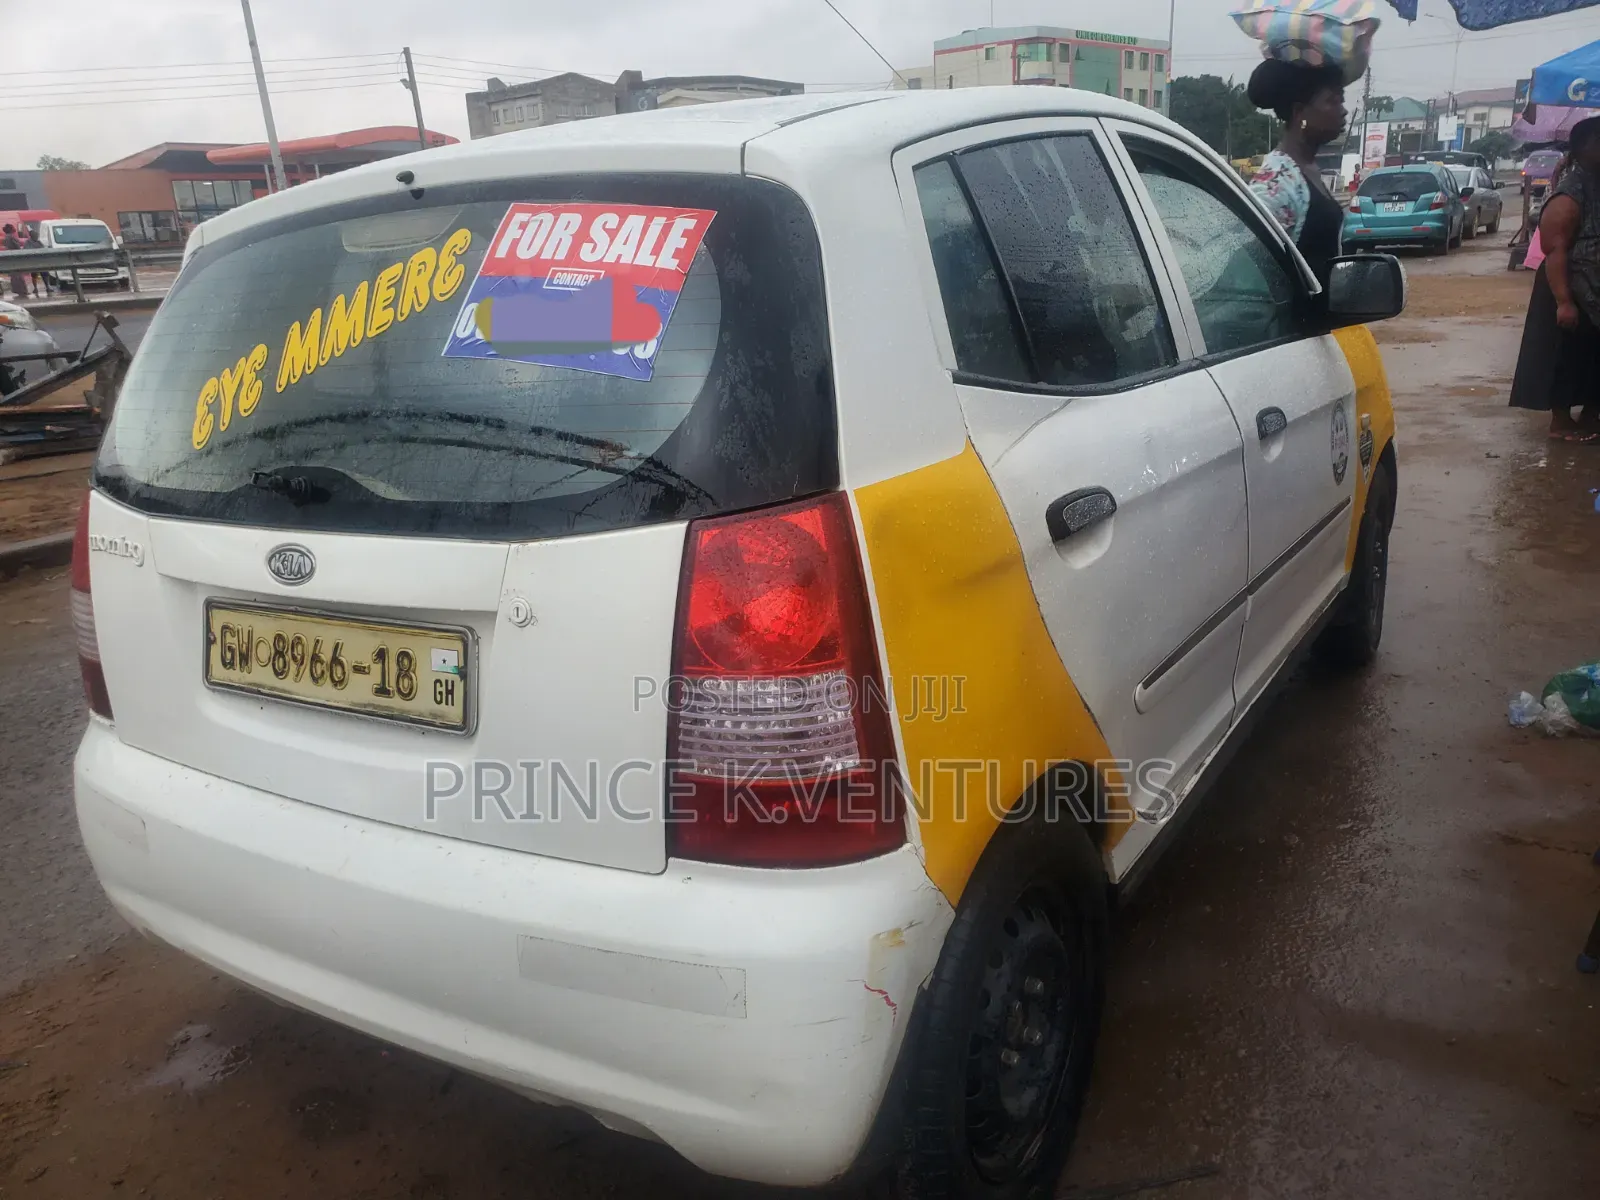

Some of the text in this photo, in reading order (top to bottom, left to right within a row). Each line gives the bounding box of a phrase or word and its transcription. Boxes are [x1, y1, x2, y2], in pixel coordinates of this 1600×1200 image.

[494, 212, 698, 271] FOR SALE
[552, 271, 595, 287] CONTACT
[433, 678, 455, 707] GH
